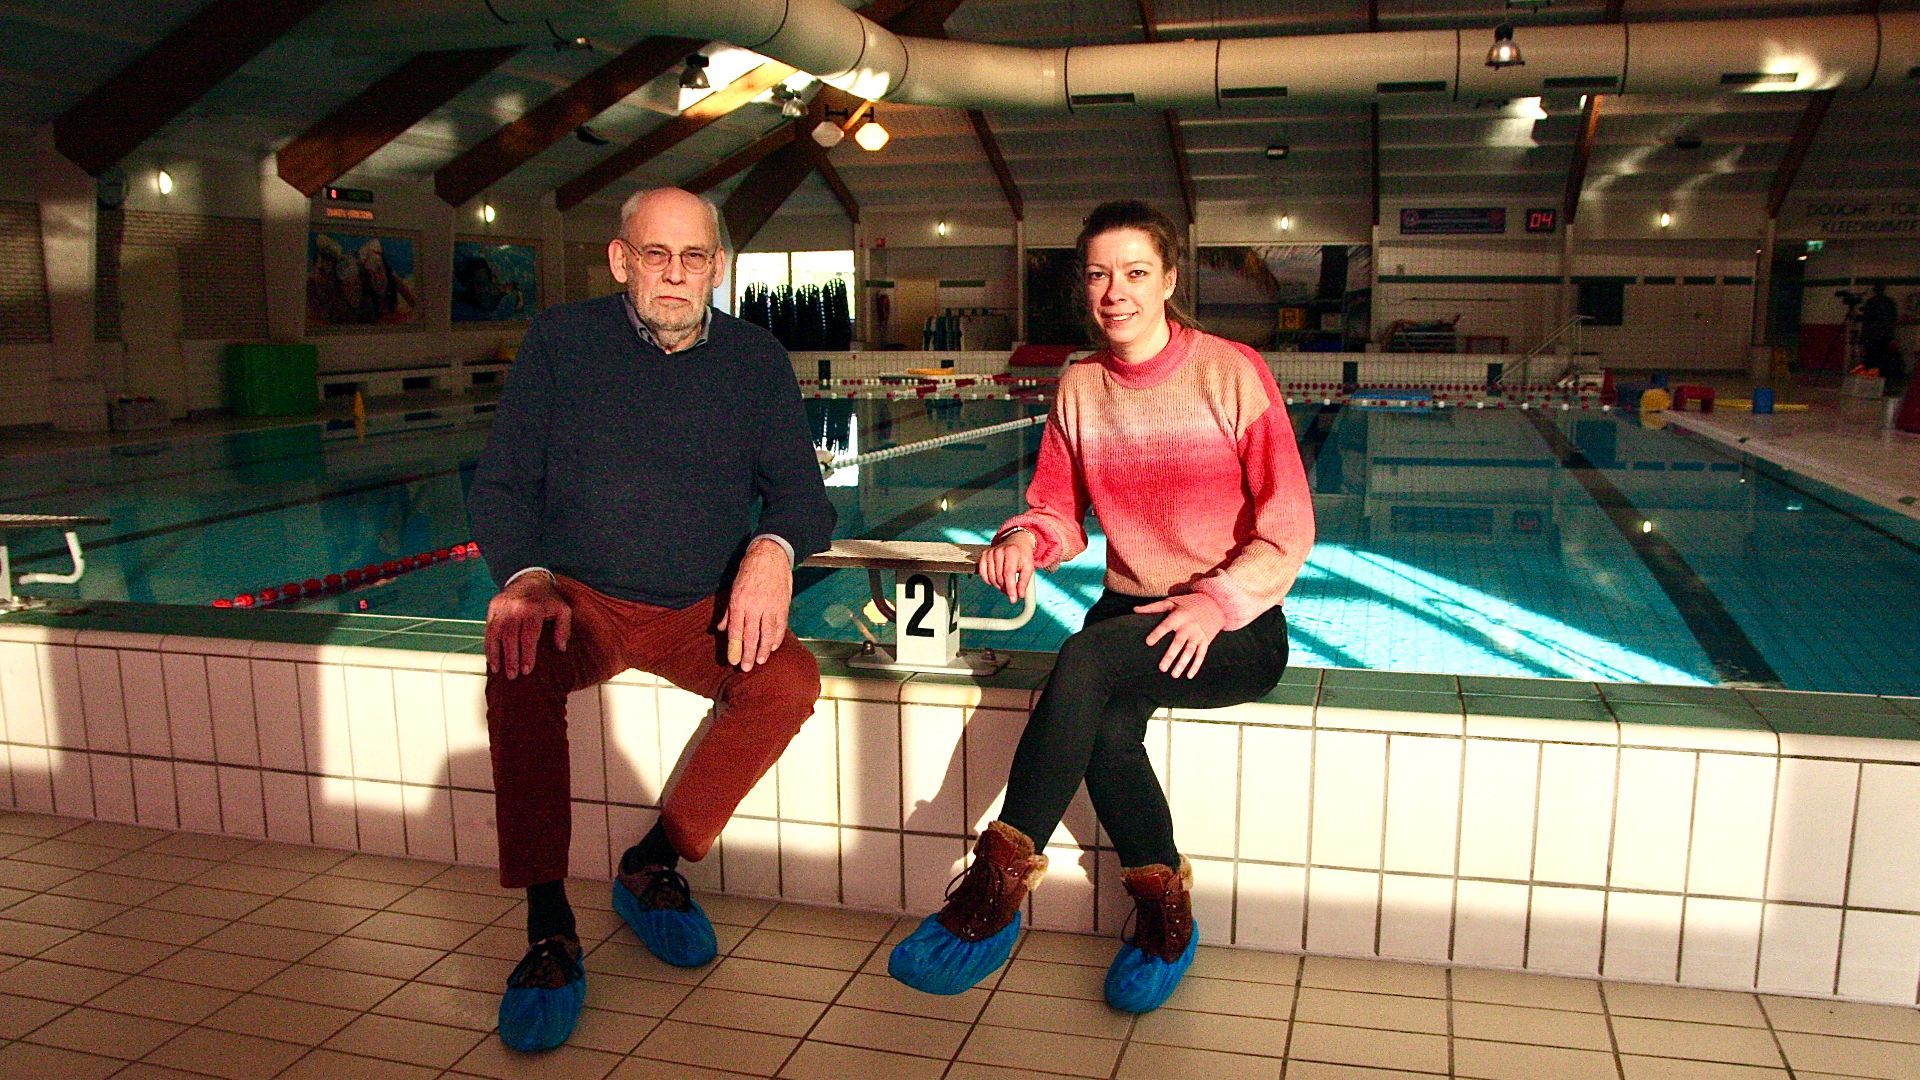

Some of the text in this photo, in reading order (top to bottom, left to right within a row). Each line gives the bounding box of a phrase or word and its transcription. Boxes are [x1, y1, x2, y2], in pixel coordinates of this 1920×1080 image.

[1530, 212, 1553, 228] 04
[905, 574, 934, 637] 2
[948, 573, 957, 634] 2
